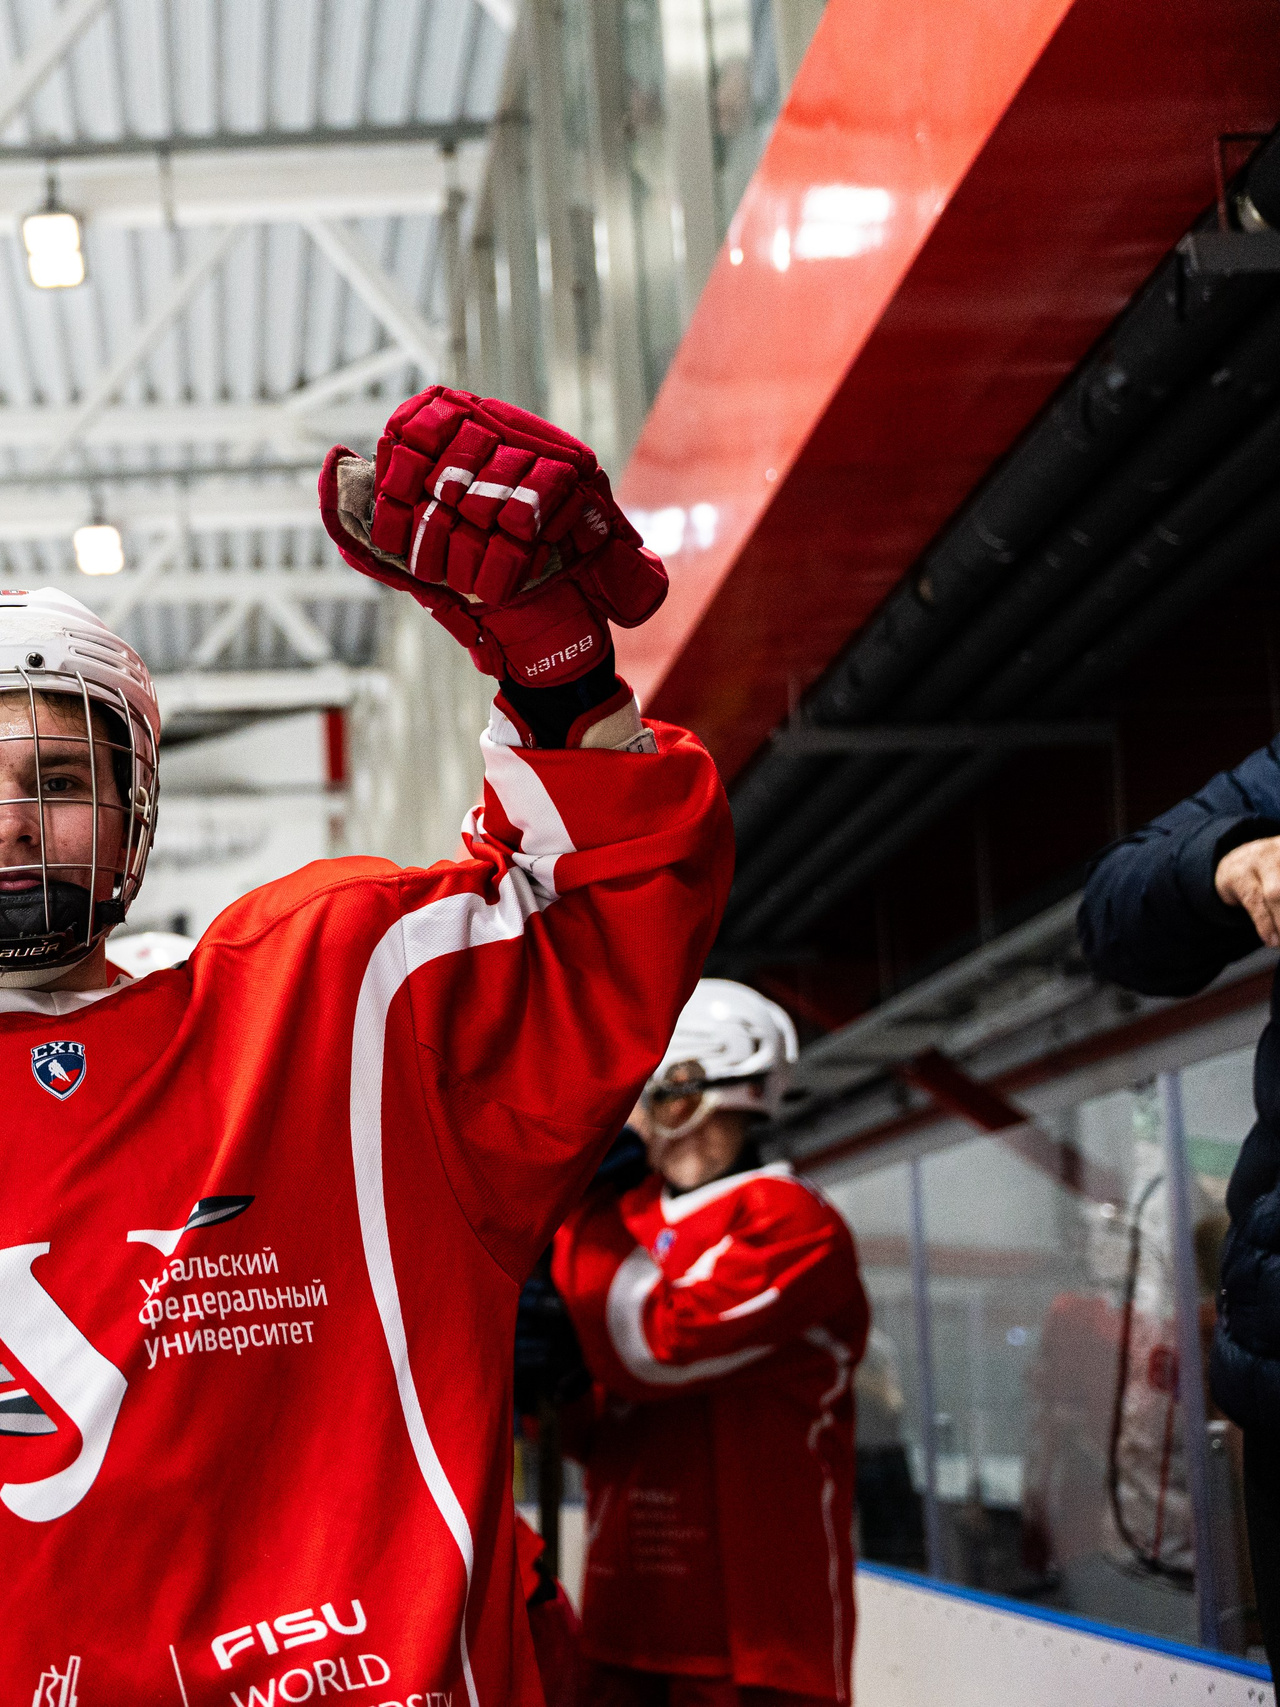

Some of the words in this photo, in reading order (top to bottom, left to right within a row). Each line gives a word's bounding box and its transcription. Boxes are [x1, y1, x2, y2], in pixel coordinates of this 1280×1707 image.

[525, 634, 593, 677] BAUER
[138, 1278, 329, 1331] федеральный
[143, 1320, 315, 1370] университет
[211, 1599, 368, 1671] FISU
[229, 1653, 392, 1707] WORLD
